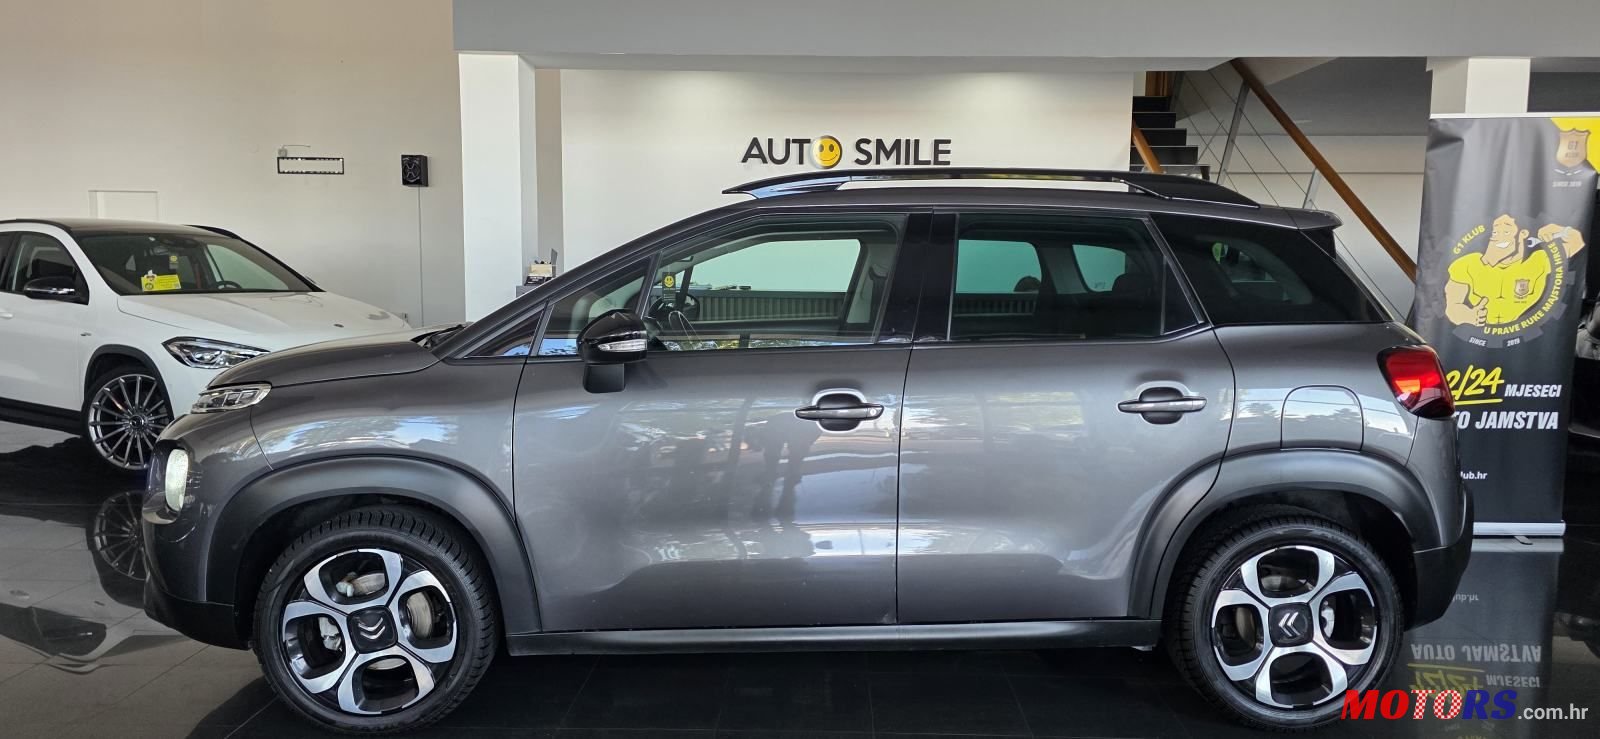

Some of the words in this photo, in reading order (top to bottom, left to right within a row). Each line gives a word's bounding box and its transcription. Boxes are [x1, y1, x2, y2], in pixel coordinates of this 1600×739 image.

[854, 138, 952, 166] SMILE
[1453, 242, 1464, 254] G1
[1462, 225, 1485, 244] KLUB
[1483, 326, 1491, 335] U
[1491, 323, 1520, 335] PRAVE
[1520, 310, 1545, 329] RUKE
[1542, 266, 1563, 312] MAJSTORA
[1445, 364, 1505, 401] 2/24
[1504, 384, 1562, 398] MJESECI
[1474, 410, 1559, 430] JAMSTVA
